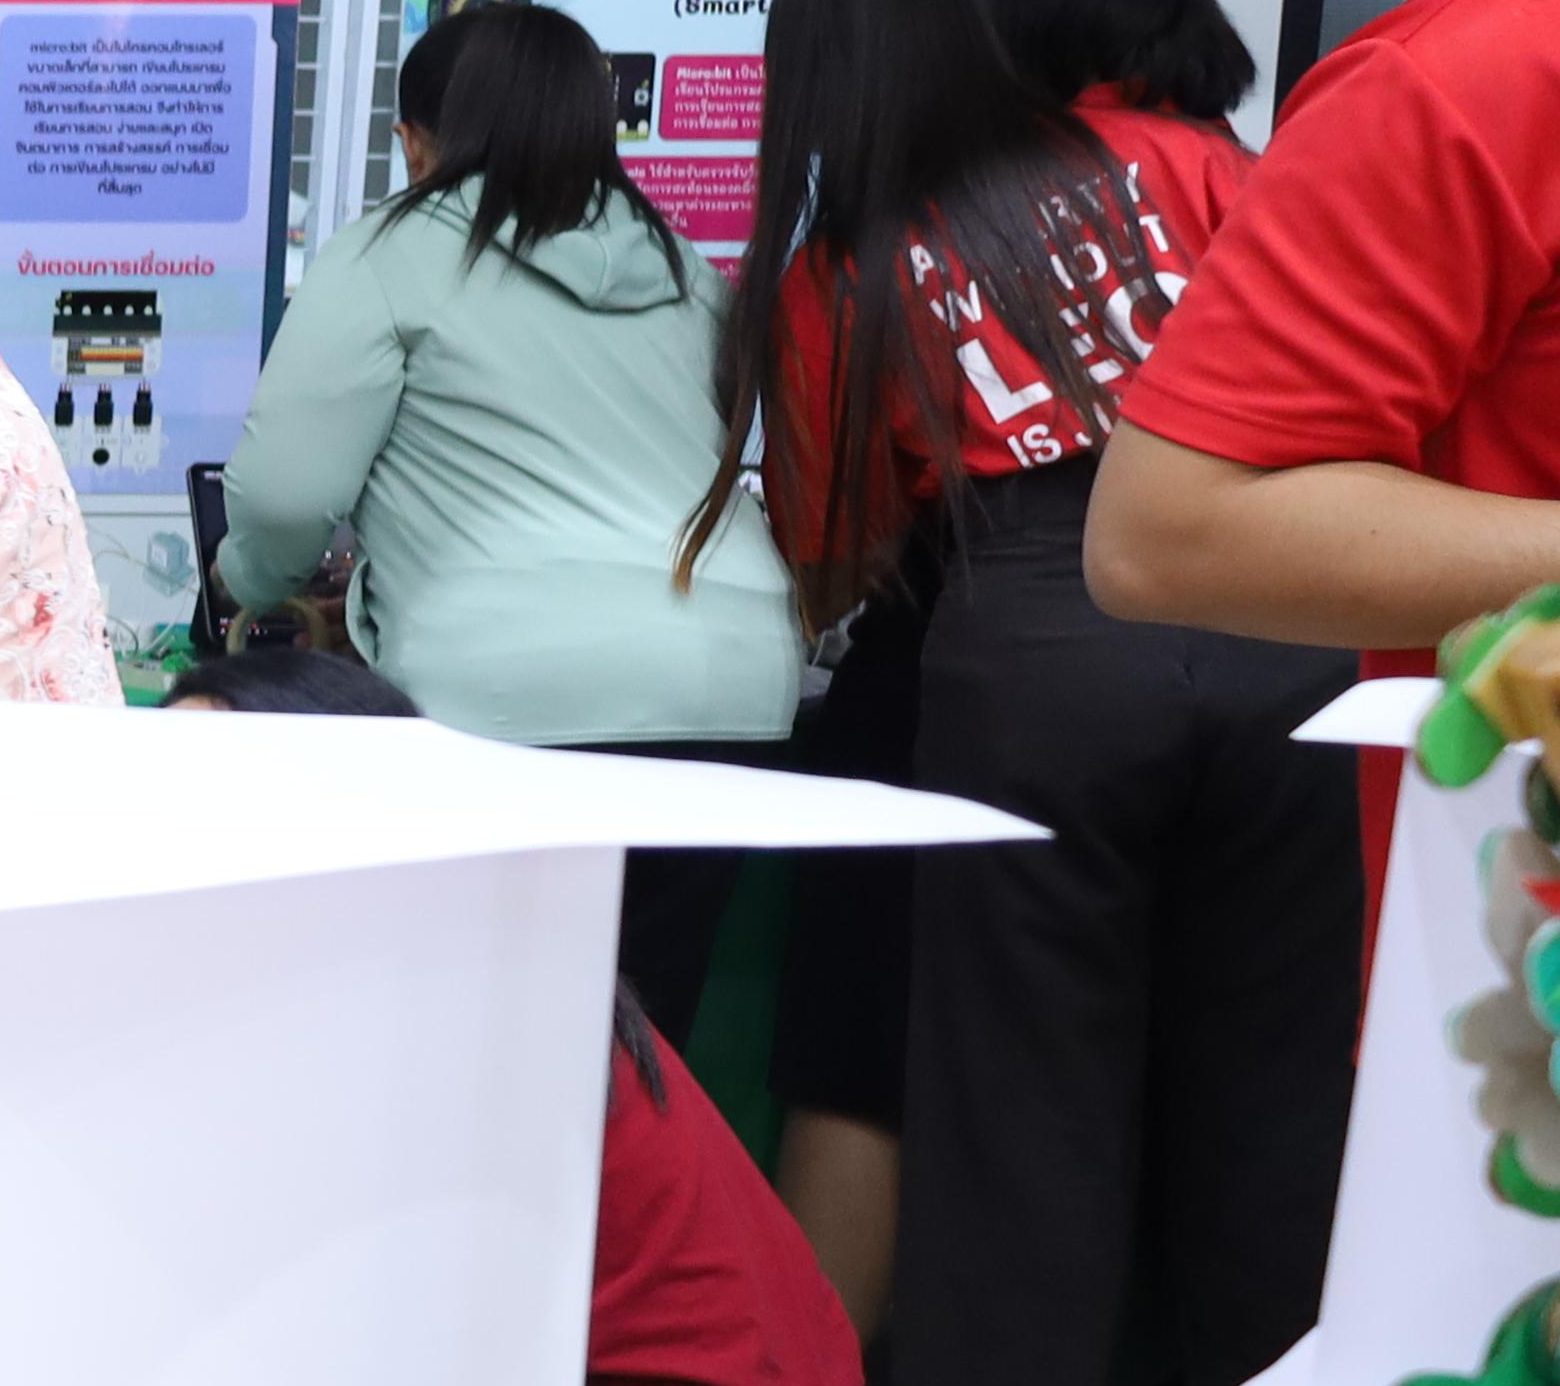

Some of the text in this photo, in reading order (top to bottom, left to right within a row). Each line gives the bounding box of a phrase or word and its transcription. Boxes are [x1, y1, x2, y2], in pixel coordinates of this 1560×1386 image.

[17, 247, 216, 278] ขั้นตอนการเชื่อมต่อ
[1006, 423, 1063, 469] IS
